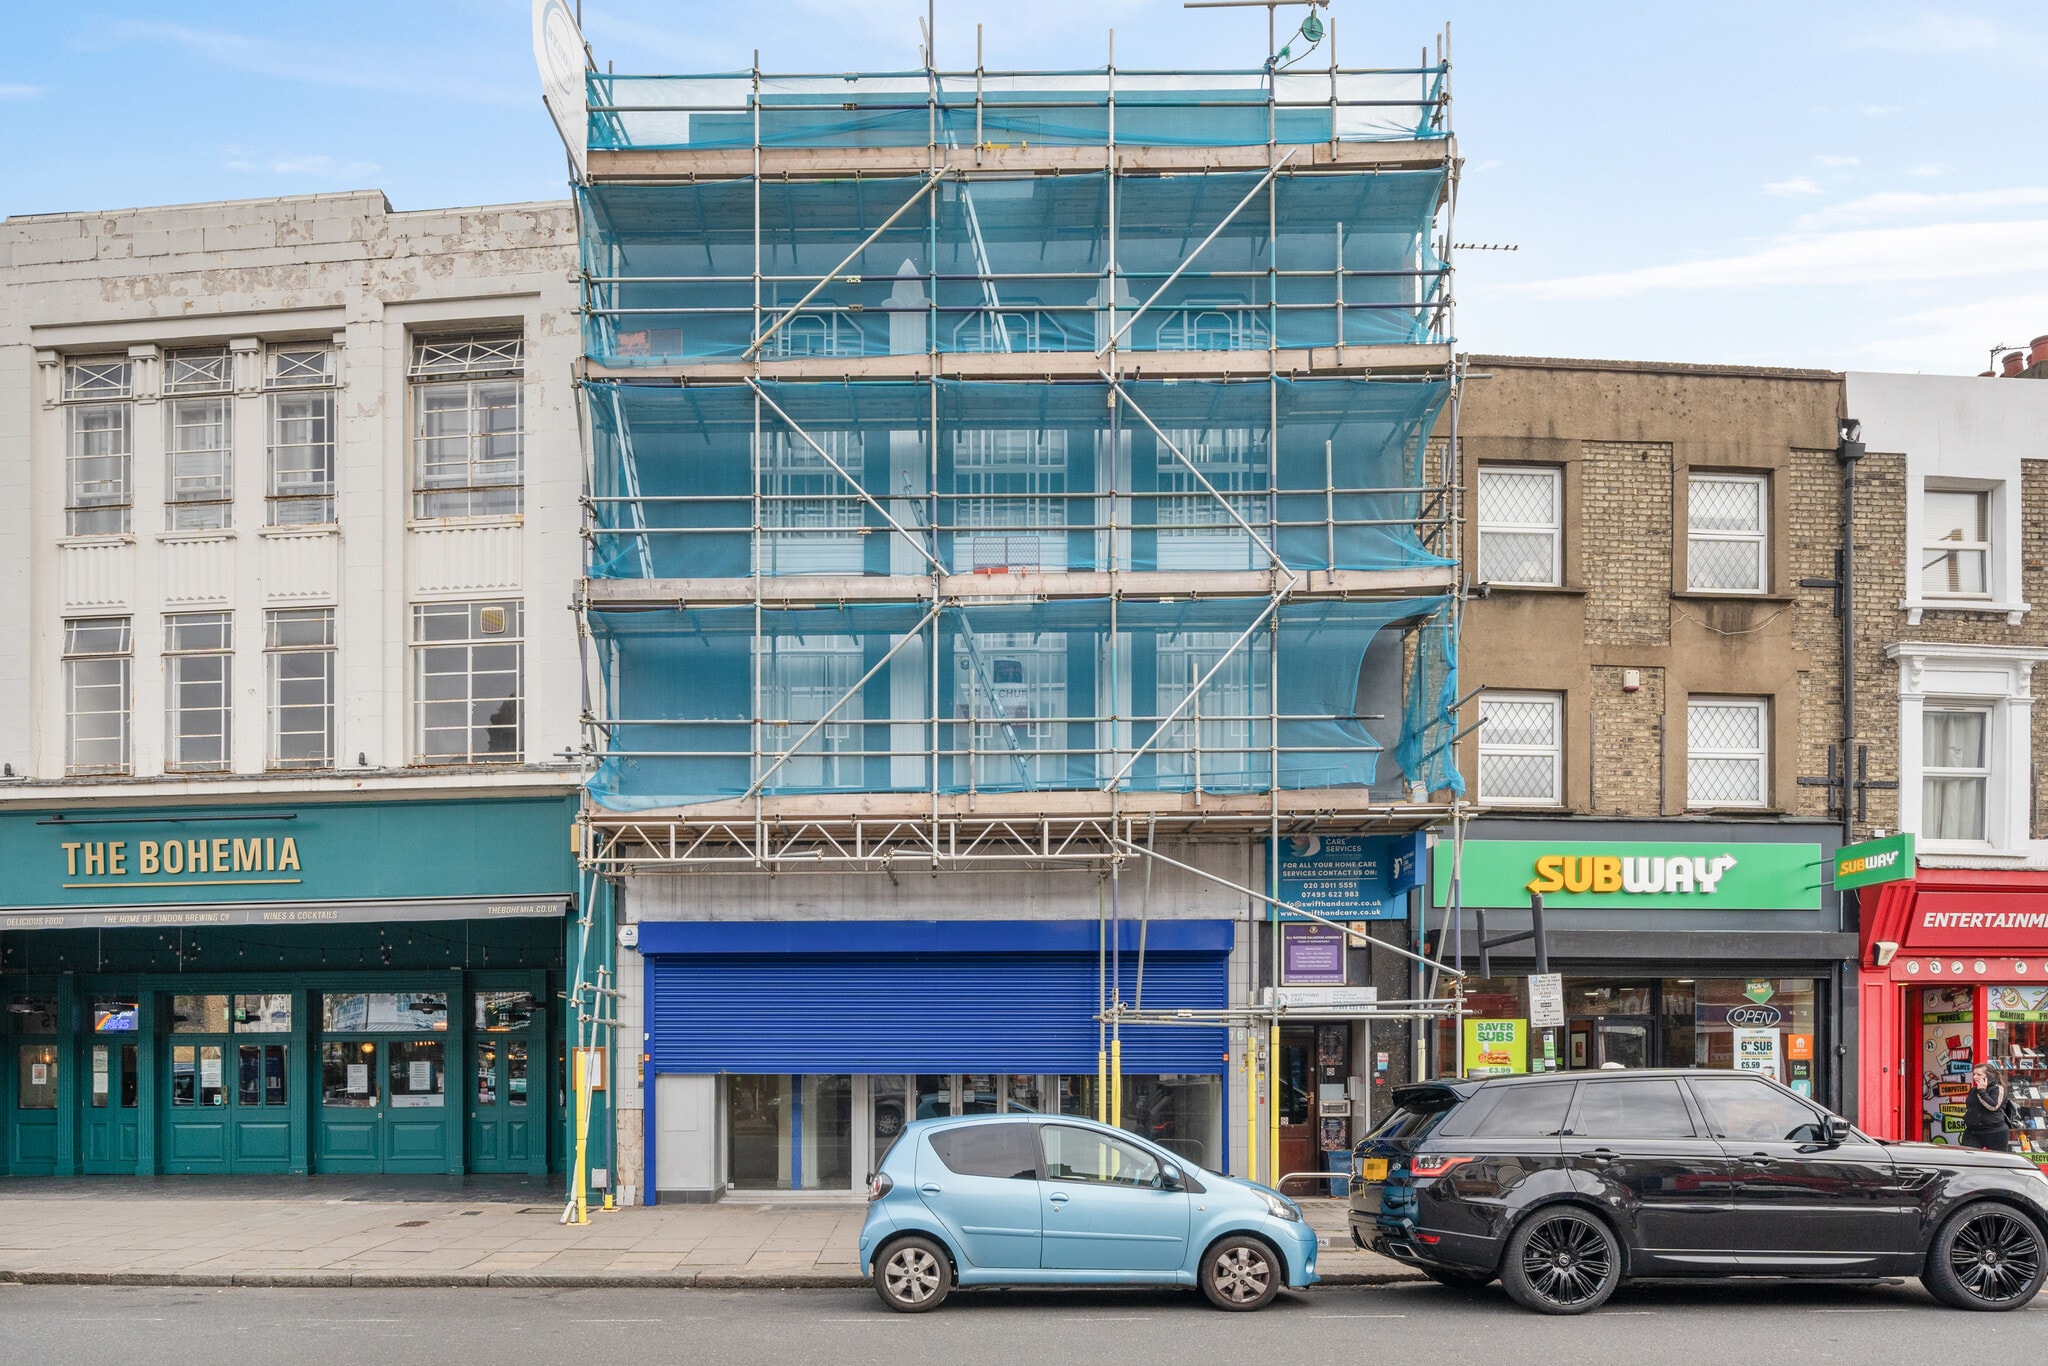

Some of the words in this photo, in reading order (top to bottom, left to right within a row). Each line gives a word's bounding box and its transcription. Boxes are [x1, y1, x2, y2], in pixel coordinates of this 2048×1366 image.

[61, 841, 127, 875] THE
[139, 837, 301, 875] BOHEMIA
[1839, 850, 1899, 877] SUBWAY
[1525, 853, 1738, 895] SUBWAY
[487, 905, 558, 914] THEBOHEMIA.CO.UK
[103, 915, 114, 923] THE
[119, 915, 140, 923] HOME
[142, 914, 152, 922] OF
[153, 914, 183, 923] LONDON
[185, 913, 218, 922] BREWING
[263, 912, 287, 920] WINES
[289, 911, 296, 920] &
[297, 910, 338, 919] COCKTAILS
[6, 917, 43, 926] DELICIOUS
[44, 916, 64, 925] FOOD
[1734, 1009, 1774, 1024] OPEN
[1937, 1013, 1961, 1022] PHONES
[1999, 1010, 2025, 1020] GAMING
[1477, 1023, 1514, 1031] SAVER
[1477, 1031, 1514, 1042] SUBS
[1753, 1041, 1773, 1051] SUB
[1741, 1061, 1760, 1069] £5.59
[1947, 1120, 1966, 1129] CASH
